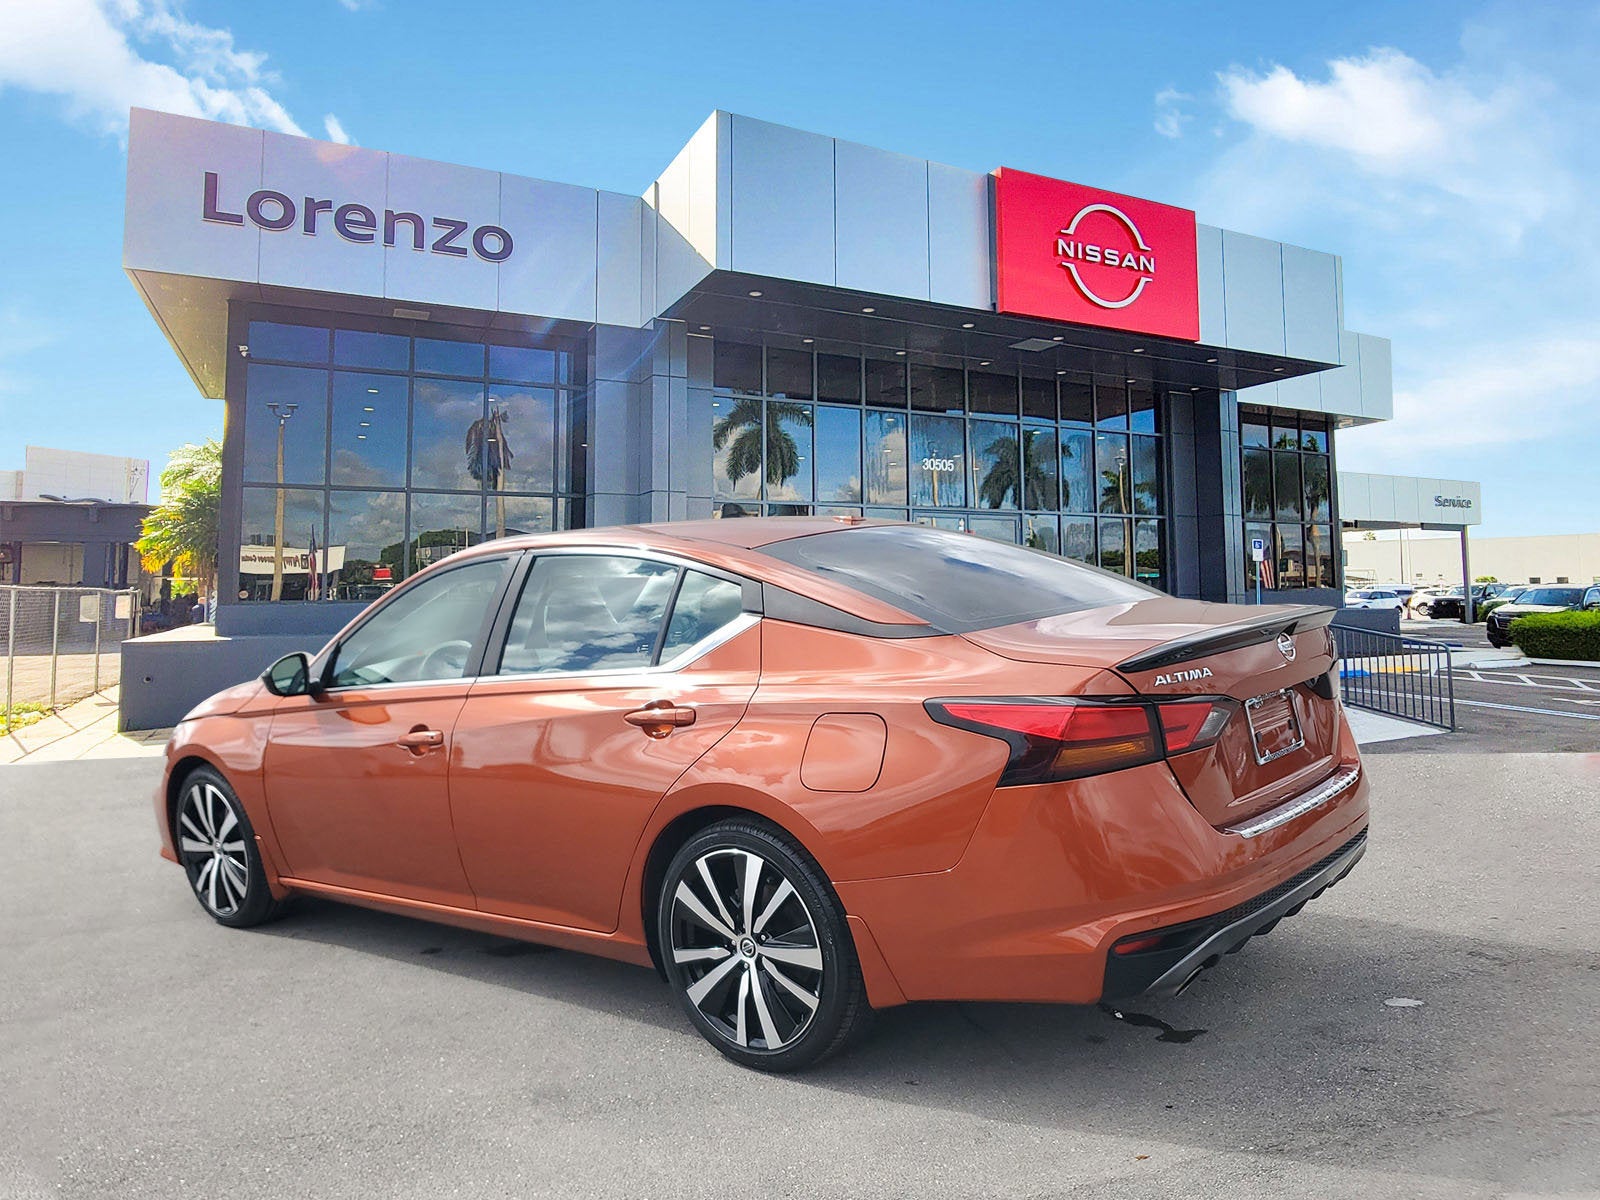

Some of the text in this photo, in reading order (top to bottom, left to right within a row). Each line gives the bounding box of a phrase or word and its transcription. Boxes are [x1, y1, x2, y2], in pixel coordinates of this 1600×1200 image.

[202, 171, 514, 263] Lorenzo
[1057, 238, 1155, 273] NISSAN
[922, 457, 955, 472] 30505
[1434, 495, 1472, 509] Service
[1153, 667, 1214, 687] ALTIMA
